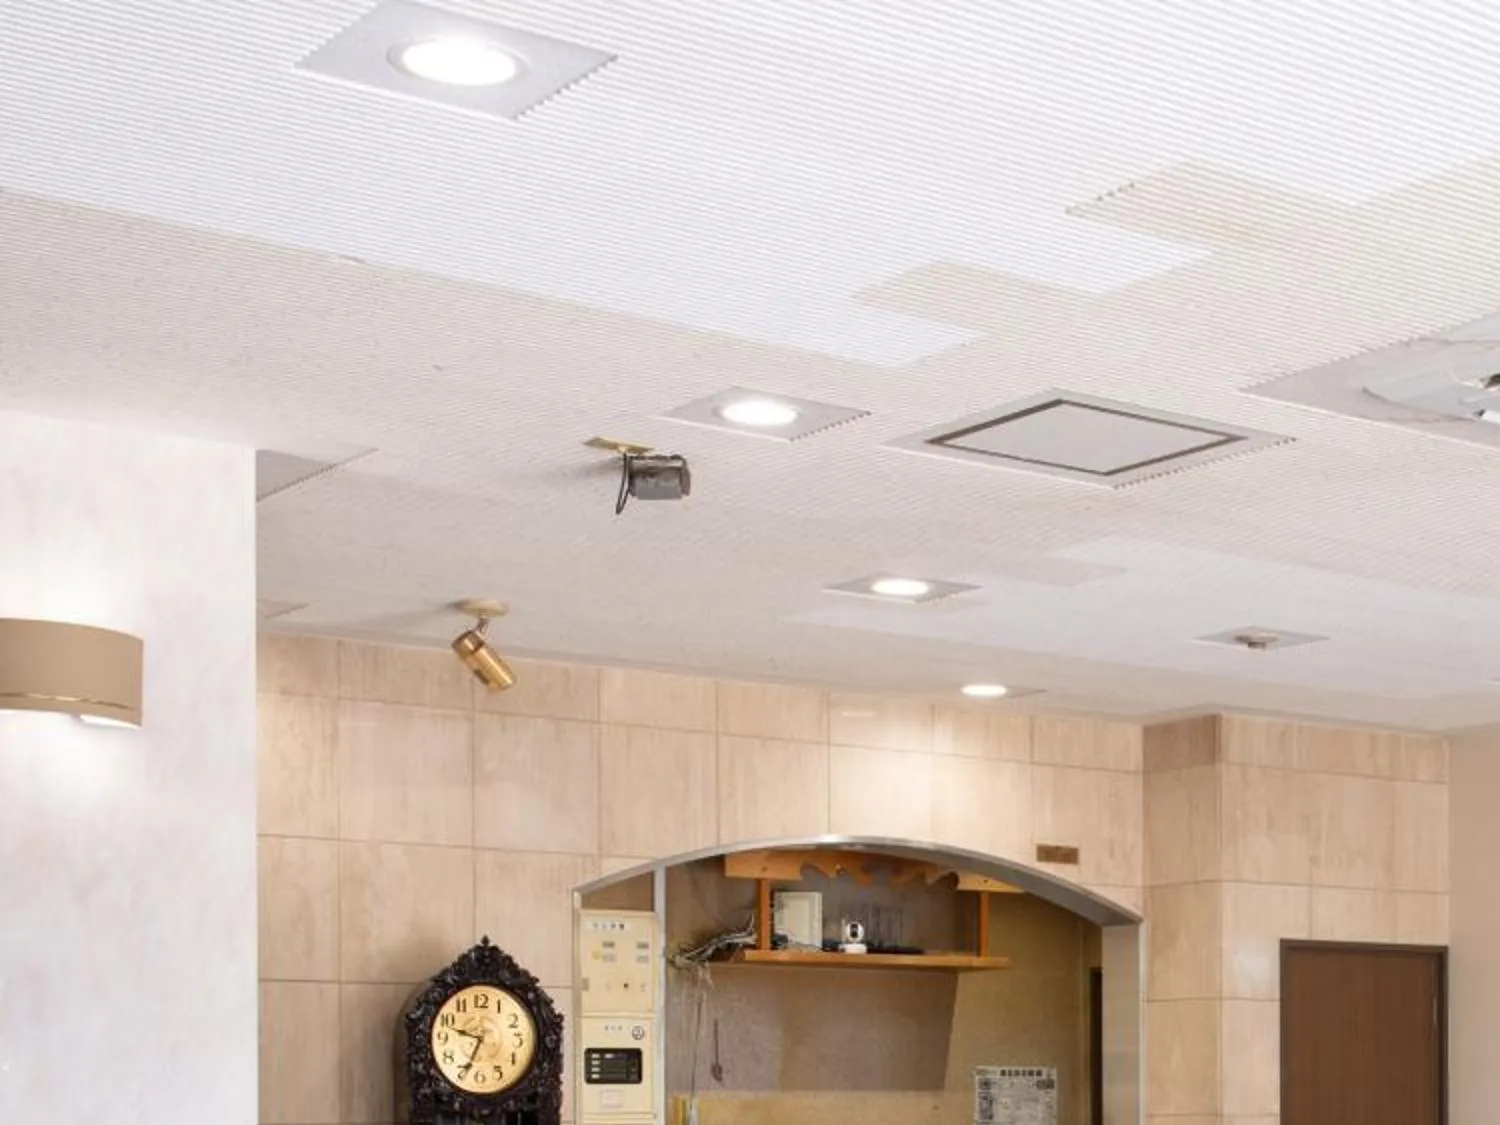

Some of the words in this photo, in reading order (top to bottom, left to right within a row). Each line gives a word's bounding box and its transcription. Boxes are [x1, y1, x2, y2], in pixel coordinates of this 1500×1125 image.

[456, 998, 467, 1013] 11
[474, 993, 489, 1009] 12
[441, 1013, 455, 1028] 10
[508, 1013, 519, 1029] 2
[437, 1030, 449, 1045] 9
[513, 1032, 523, 1049] 3
[443, 1049, 454, 1065] 8
[474, 1070, 486, 1084] 6
[493, 1065, 503, 1081] 5
